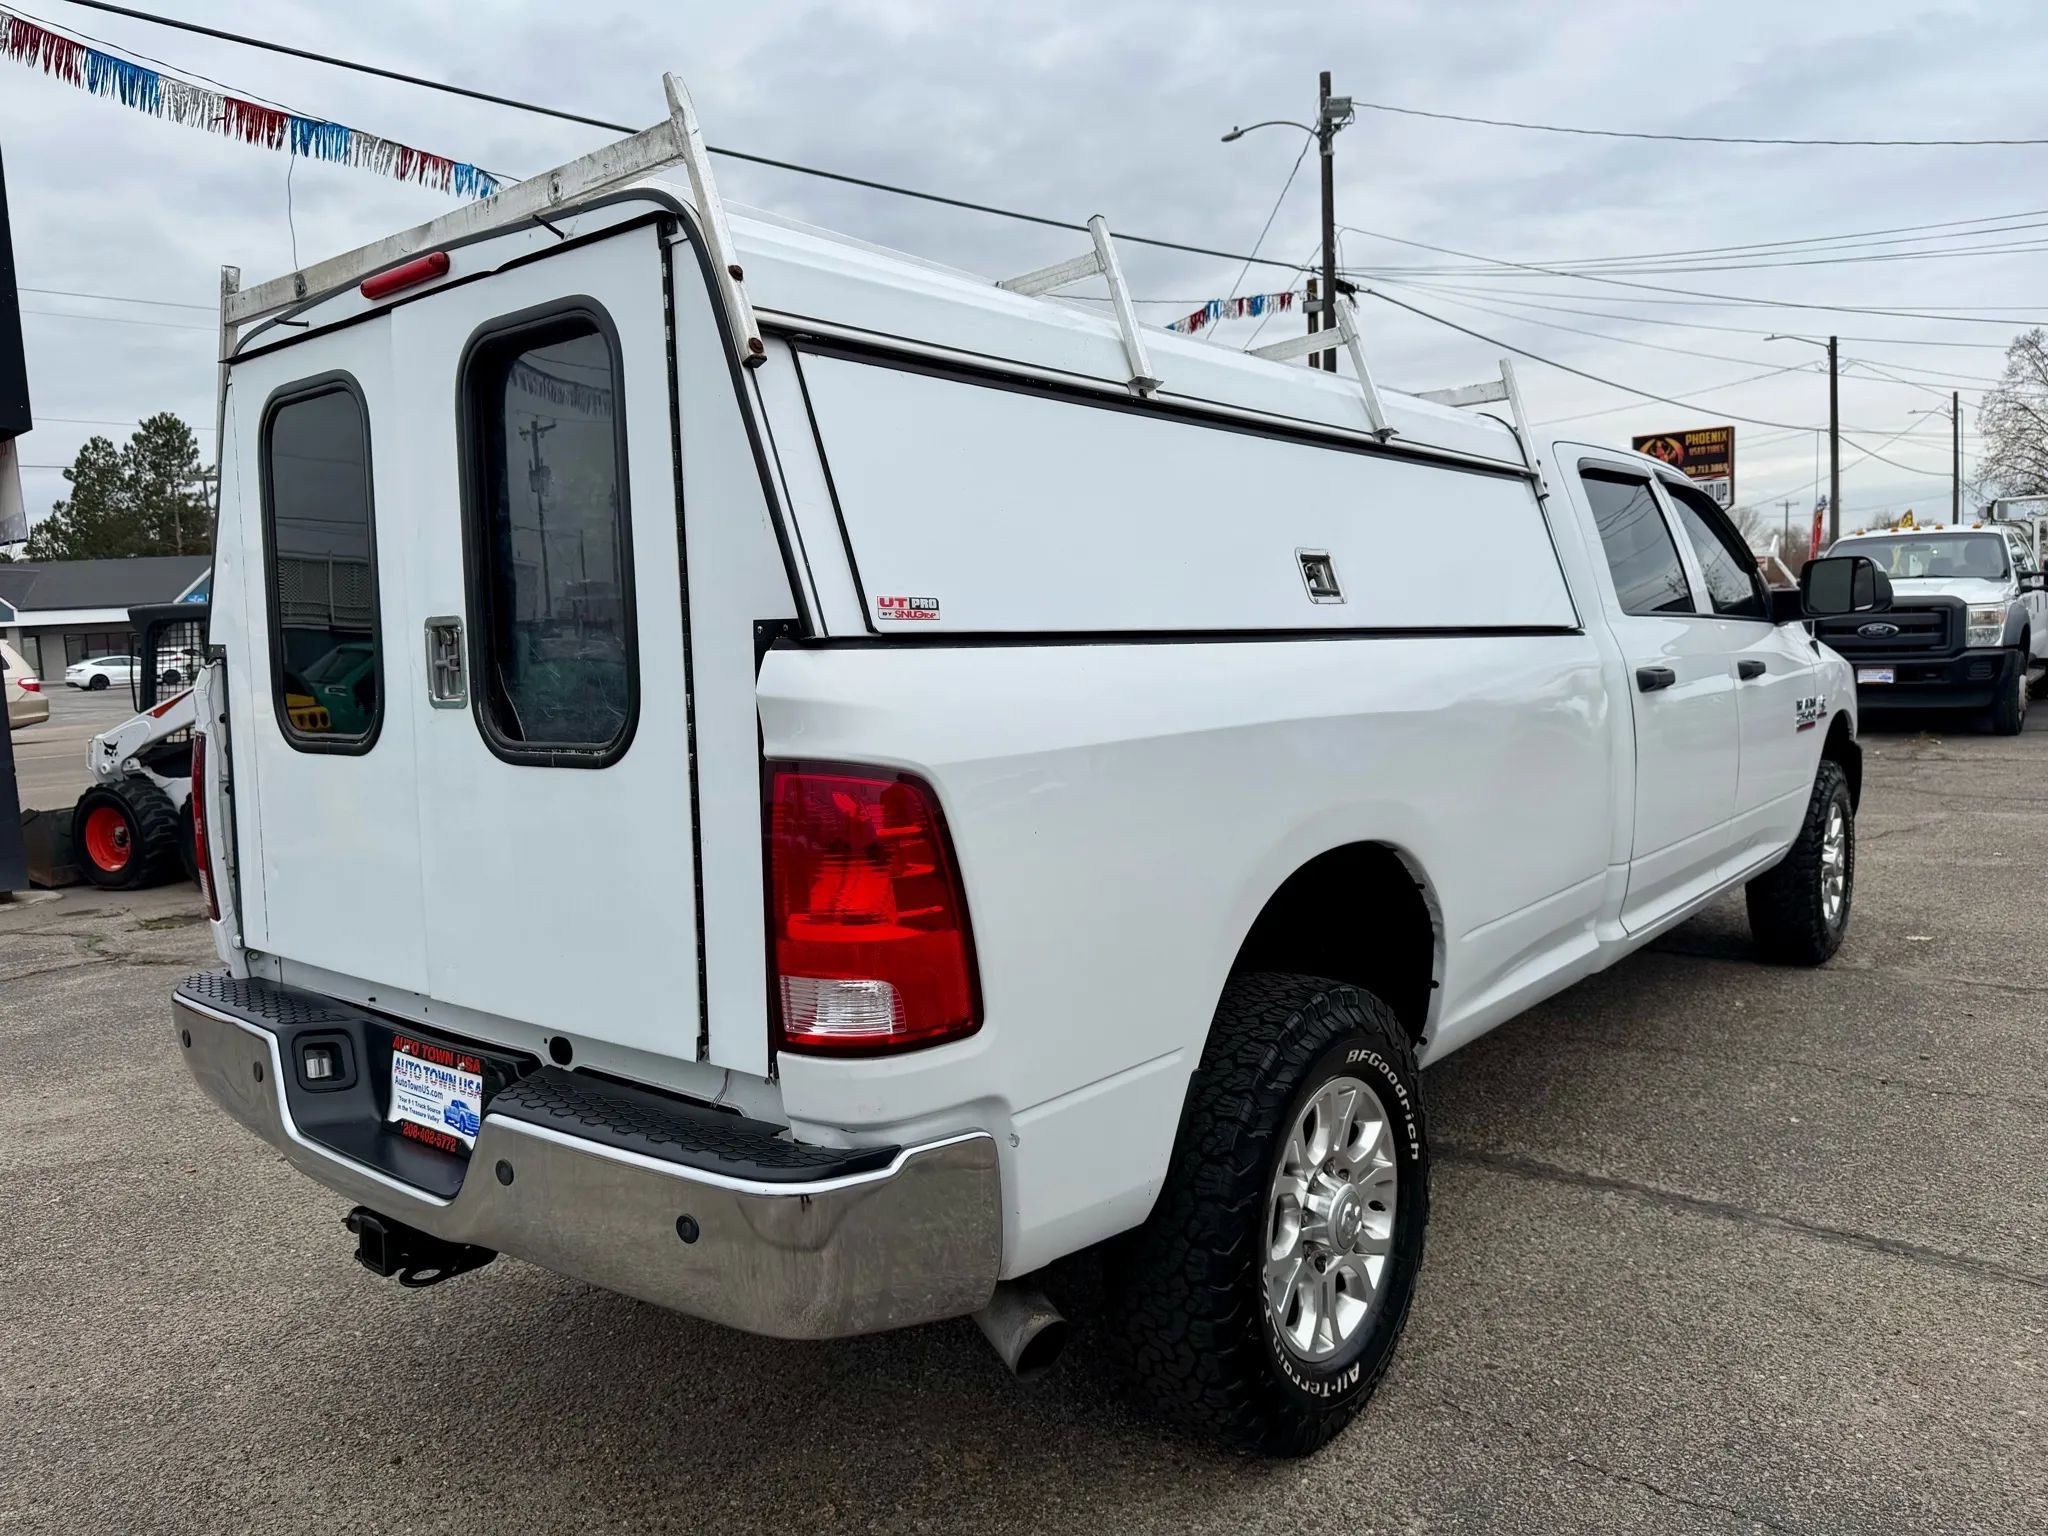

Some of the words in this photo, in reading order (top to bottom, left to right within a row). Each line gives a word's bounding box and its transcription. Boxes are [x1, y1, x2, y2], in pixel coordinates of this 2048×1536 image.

[1685, 430, 1727, 446] PHOENIX
[1716, 483, 1727, 501] UP
[879, 597, 908, 608] UT
[911, 598, 937, 609] PRO
[393, 1035, 420, 1056] AUTO
[421, 1045, 454, 1066] TOWN
[456, 1054, 481, 1073] USA
[394, 1057, 422, 1081] AUTO
[423, 1065, 457, 1092] TOWN
[458, 1077, 482, 1099] USA
[394, 1076, 444, 1100] AutoTownUS.com
[1345, 1049, 1419, 1160] BFGoodrich
